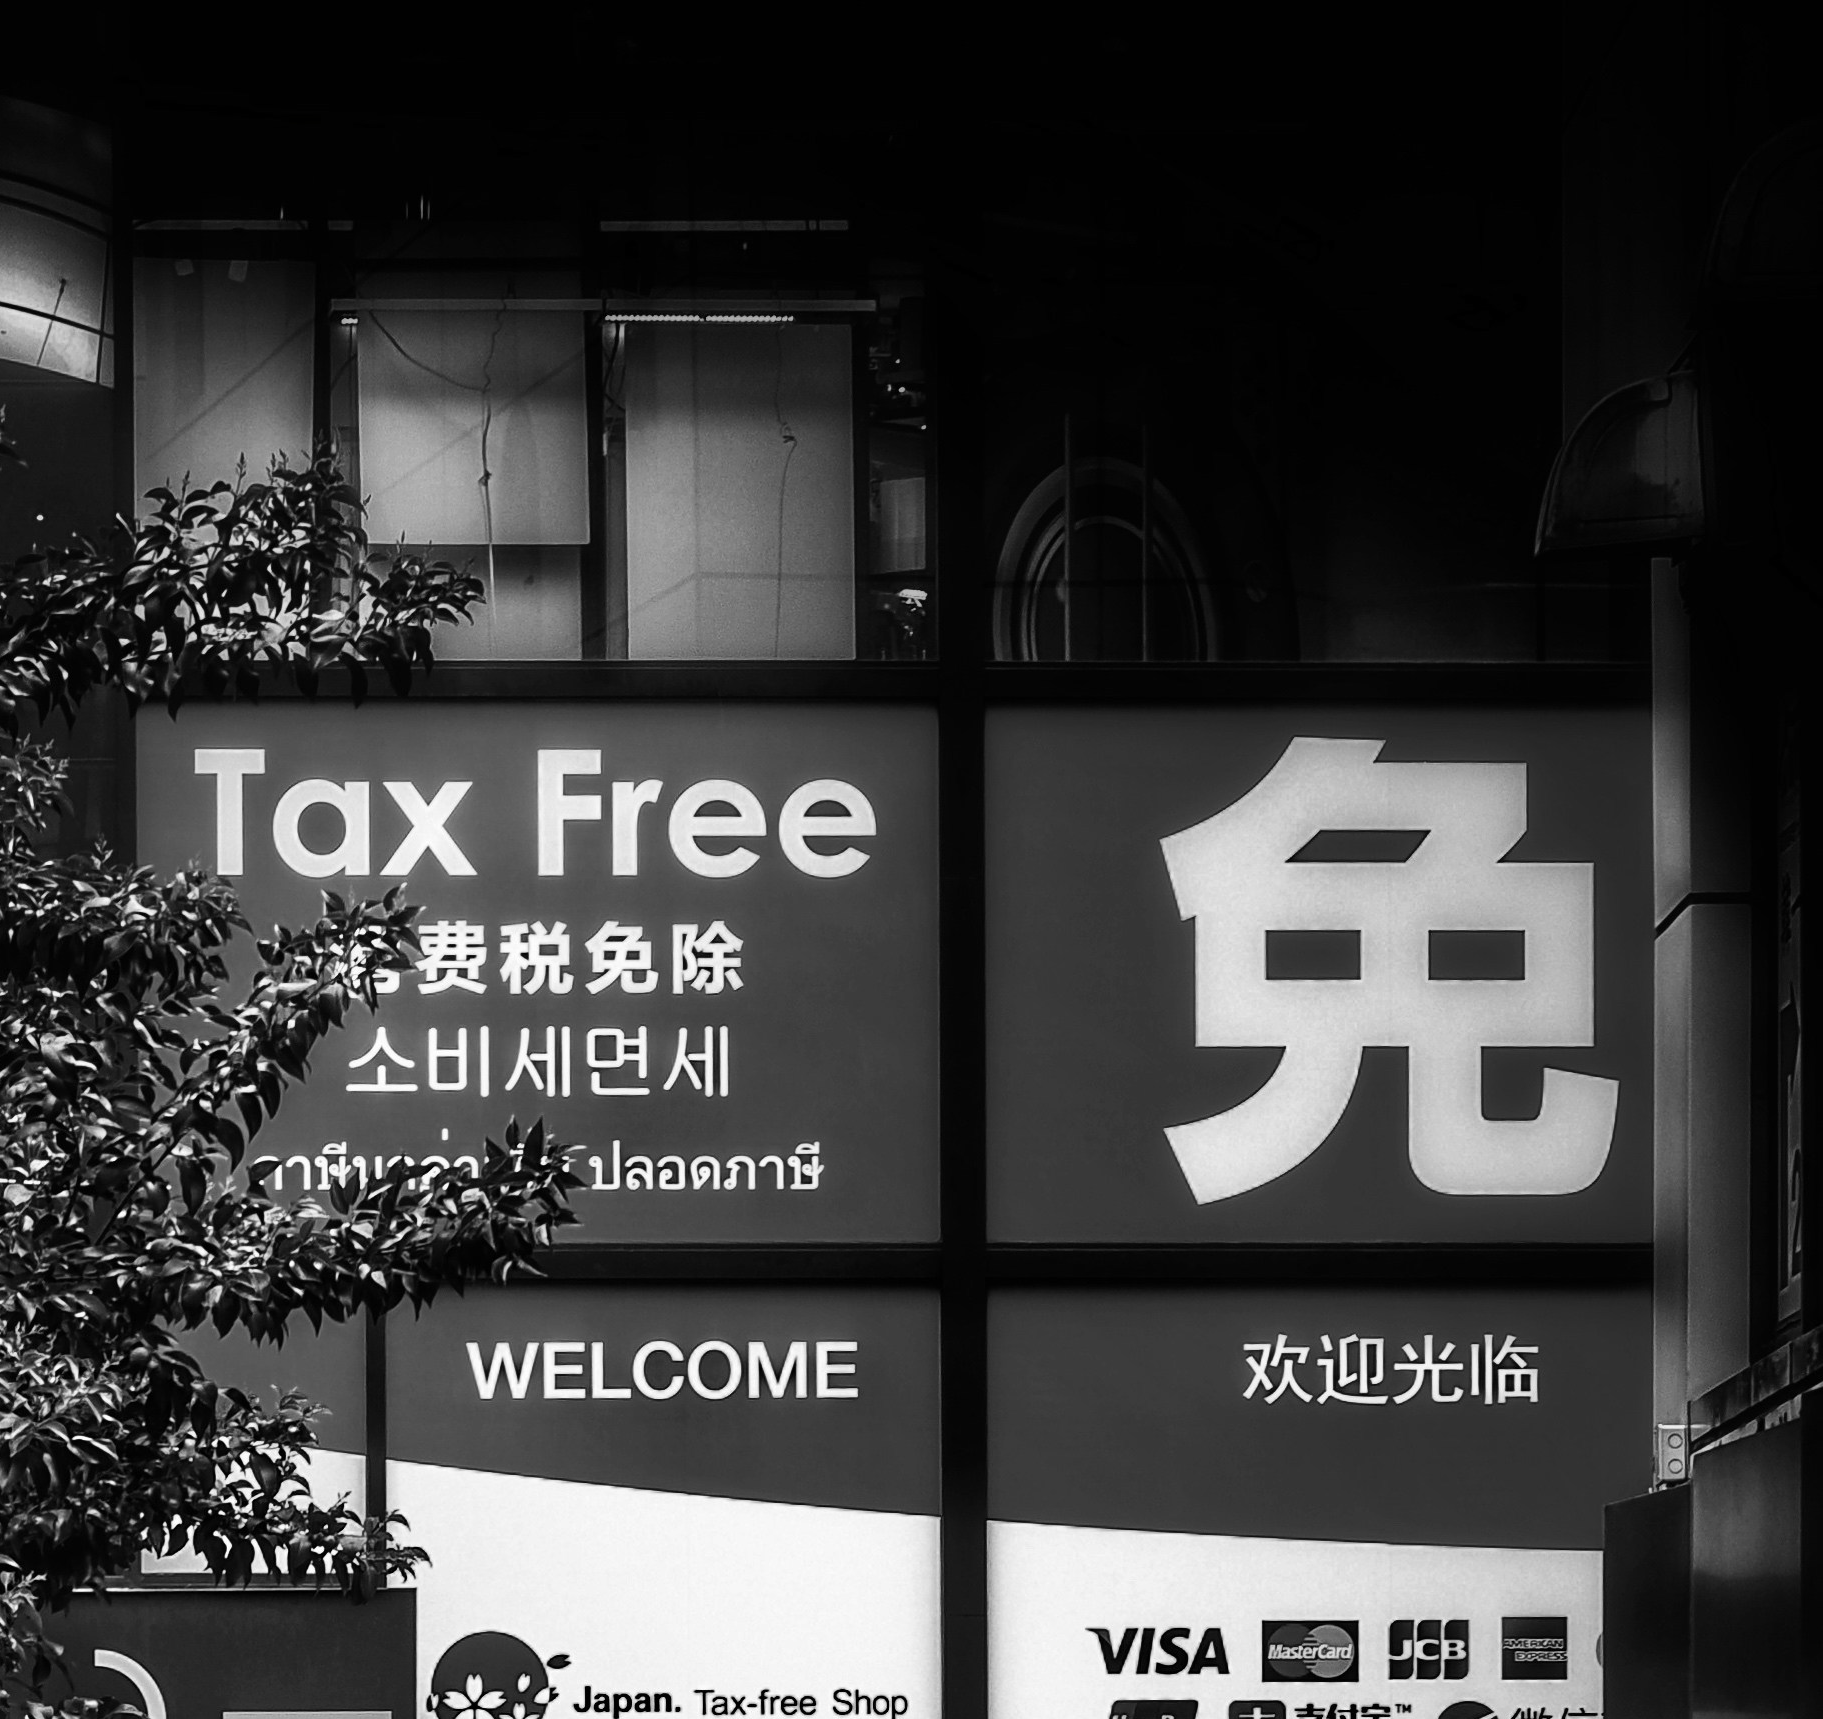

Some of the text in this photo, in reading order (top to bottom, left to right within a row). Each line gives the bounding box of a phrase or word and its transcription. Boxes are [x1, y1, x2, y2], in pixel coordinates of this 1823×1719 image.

[194, 748, 877, 878] Tax Free
[1159, 736, 1619, 1205] 免
[345, 1024, 728, 1097] 소비세면세
[588, 1139, 825, 1190] ปลอดภาษี
[466, 1340, 859, 1400] WELCOME
[1241, 1333, 1539, 1405] 欢迎光临
[1085, 1627, 1468, 1675] VISA MasterCard JCB
[1503, 1637, 1565, 1649] AMERICAN
[1514, 1651, 1568, 1662] EXPRESS
[573, 1685, 682, 1719] Japan.
[694, 1688, 818, 1717] Tax-free
